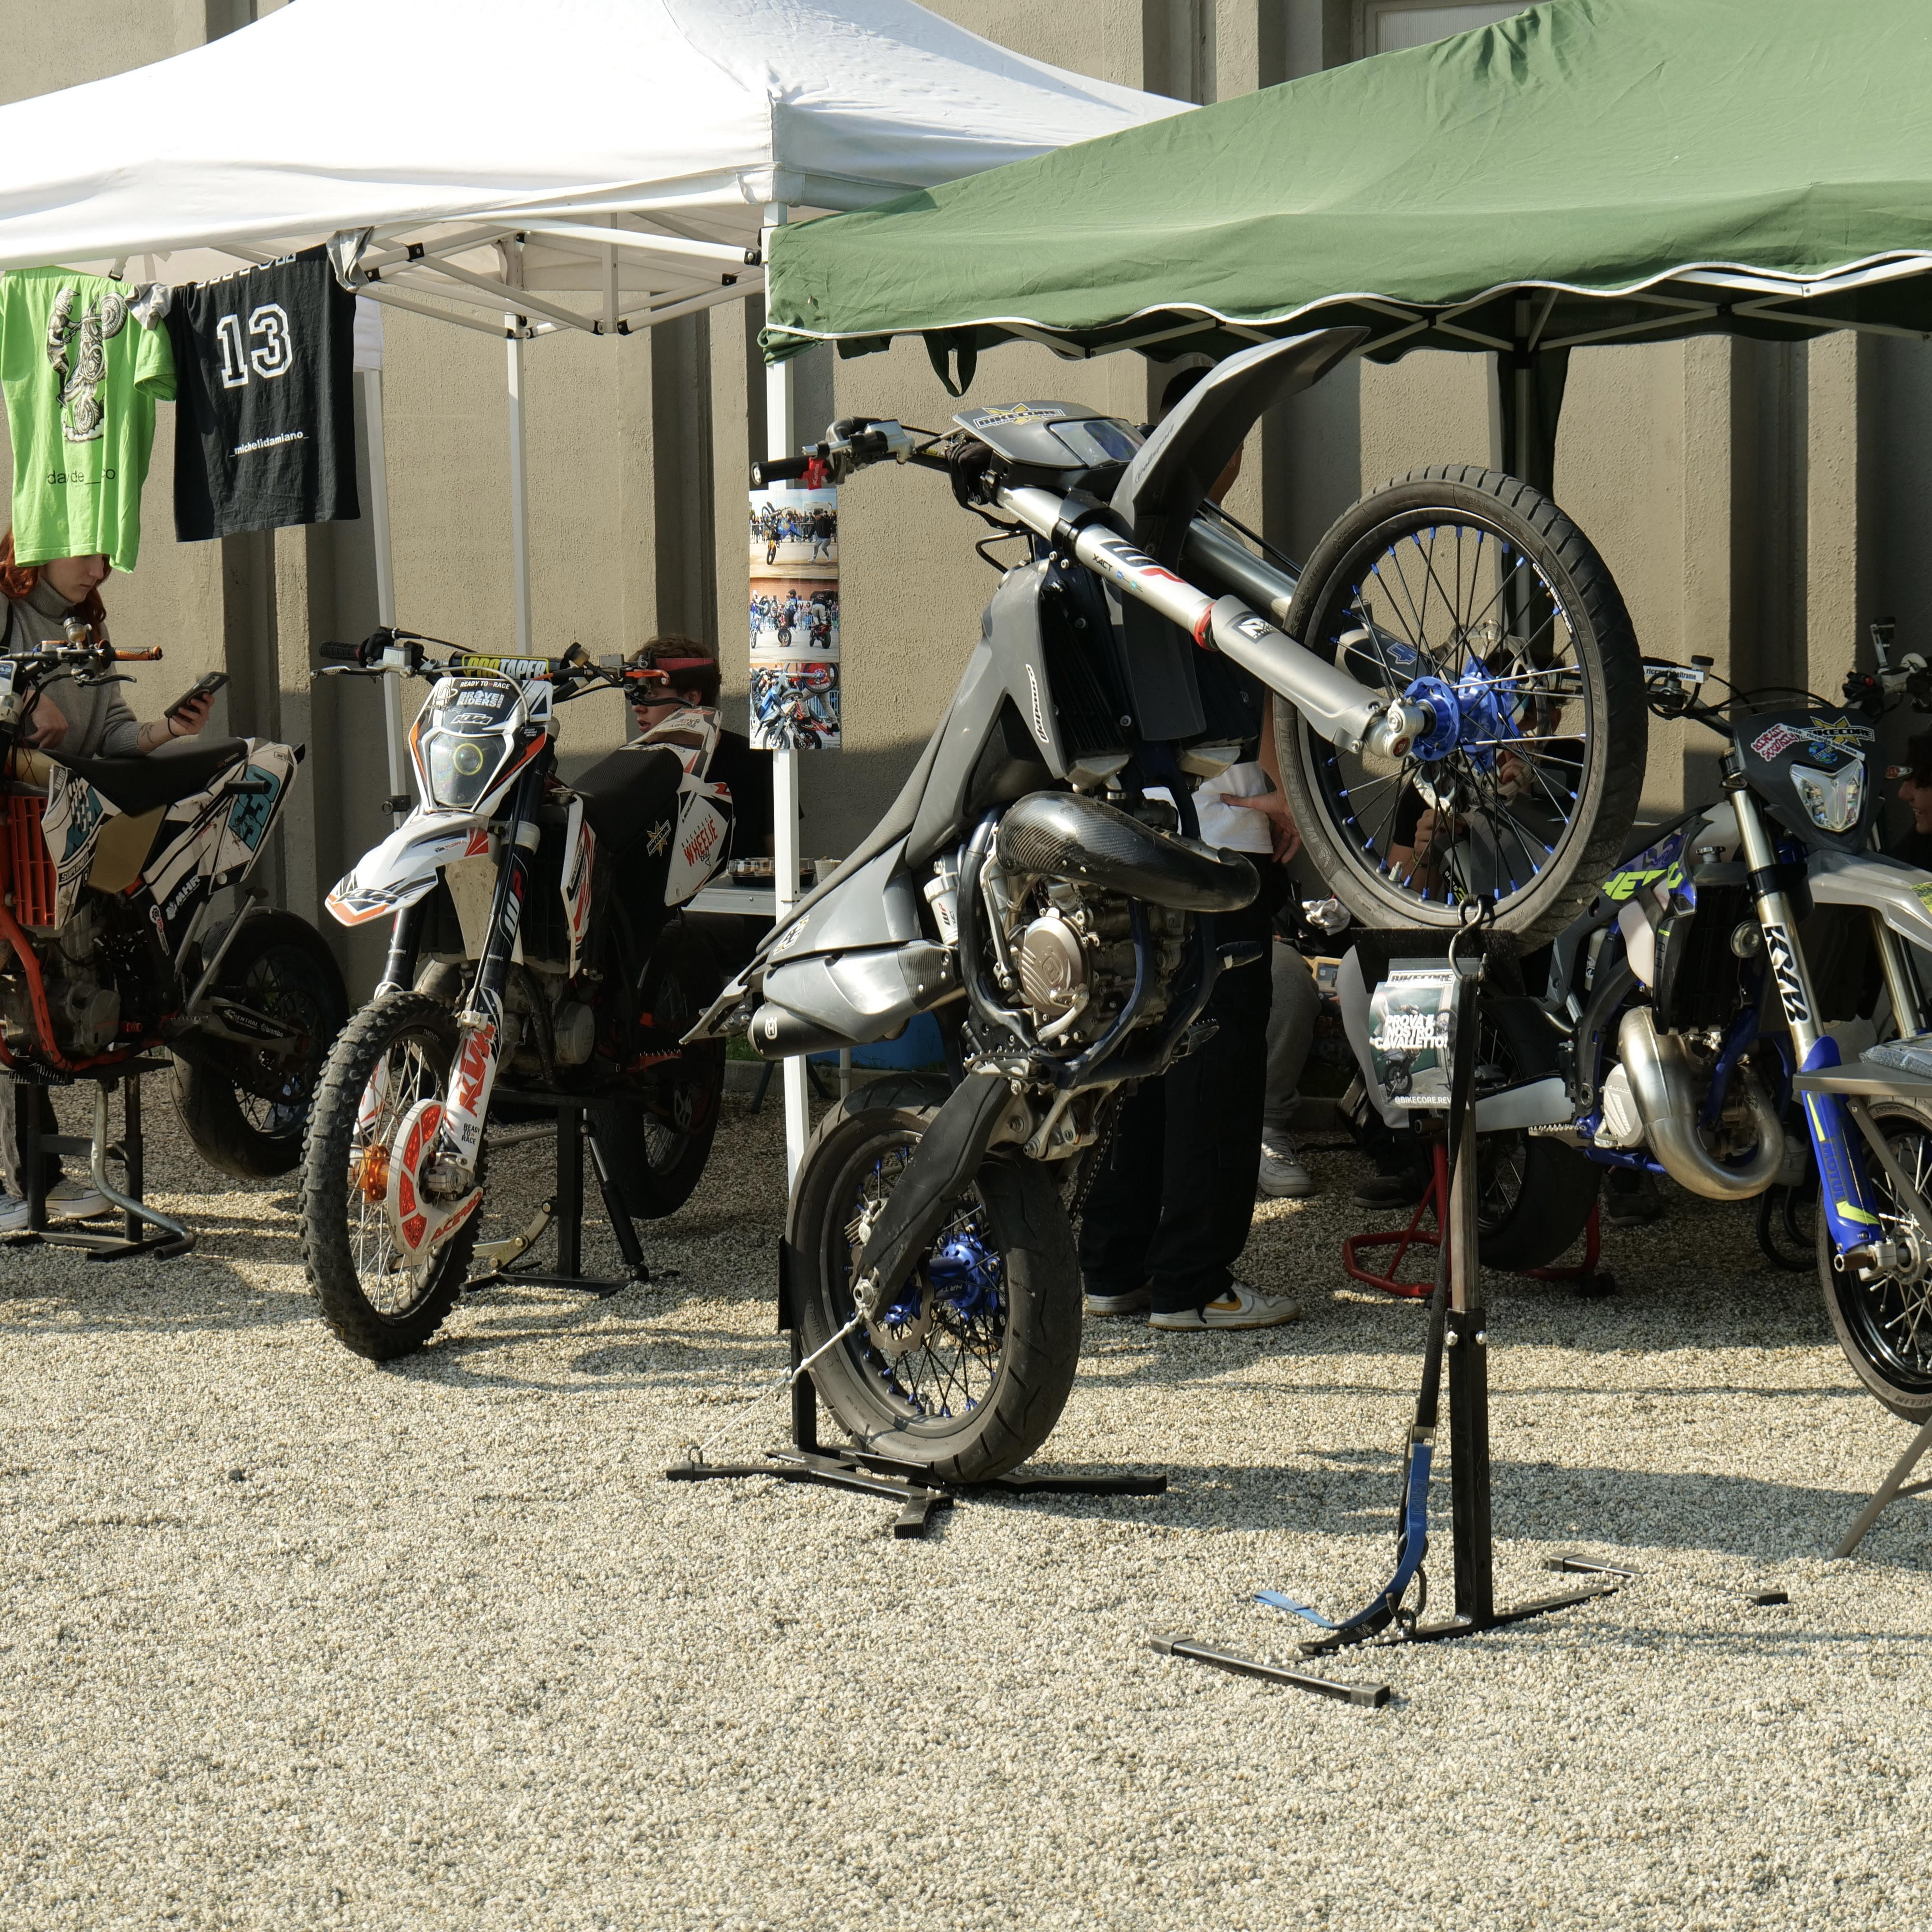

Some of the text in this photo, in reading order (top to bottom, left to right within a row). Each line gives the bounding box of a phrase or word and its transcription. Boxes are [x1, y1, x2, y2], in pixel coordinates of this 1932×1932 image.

[217, 303, 293, 389] 13
[978, 410, 1060, 426] BIKECORE
[1093, 554, 1113, 571] XACT
[456, 697, 497, 708] RIDERS
[683, 818, 718, 867] WHEELIE
[175, 874, 201, 907] MHR
[1762, 922, 1811, 1025] KYB
[1384, 1013, 1435, 1027] PROVA IL
[423, 1028, 440, 1043] TWENTY
[1386, 1025, 1435, 1038] NOSTRO
[1374, 1037, 1449, 1051] CAVALLETTO!
[456, 1022, 496, 1118] KTM
[463, 1122, 480, 1135] READY
[461, 1135, 477, 1145] RACE
[1822, 1142, 1847, 1201] MOTUL
